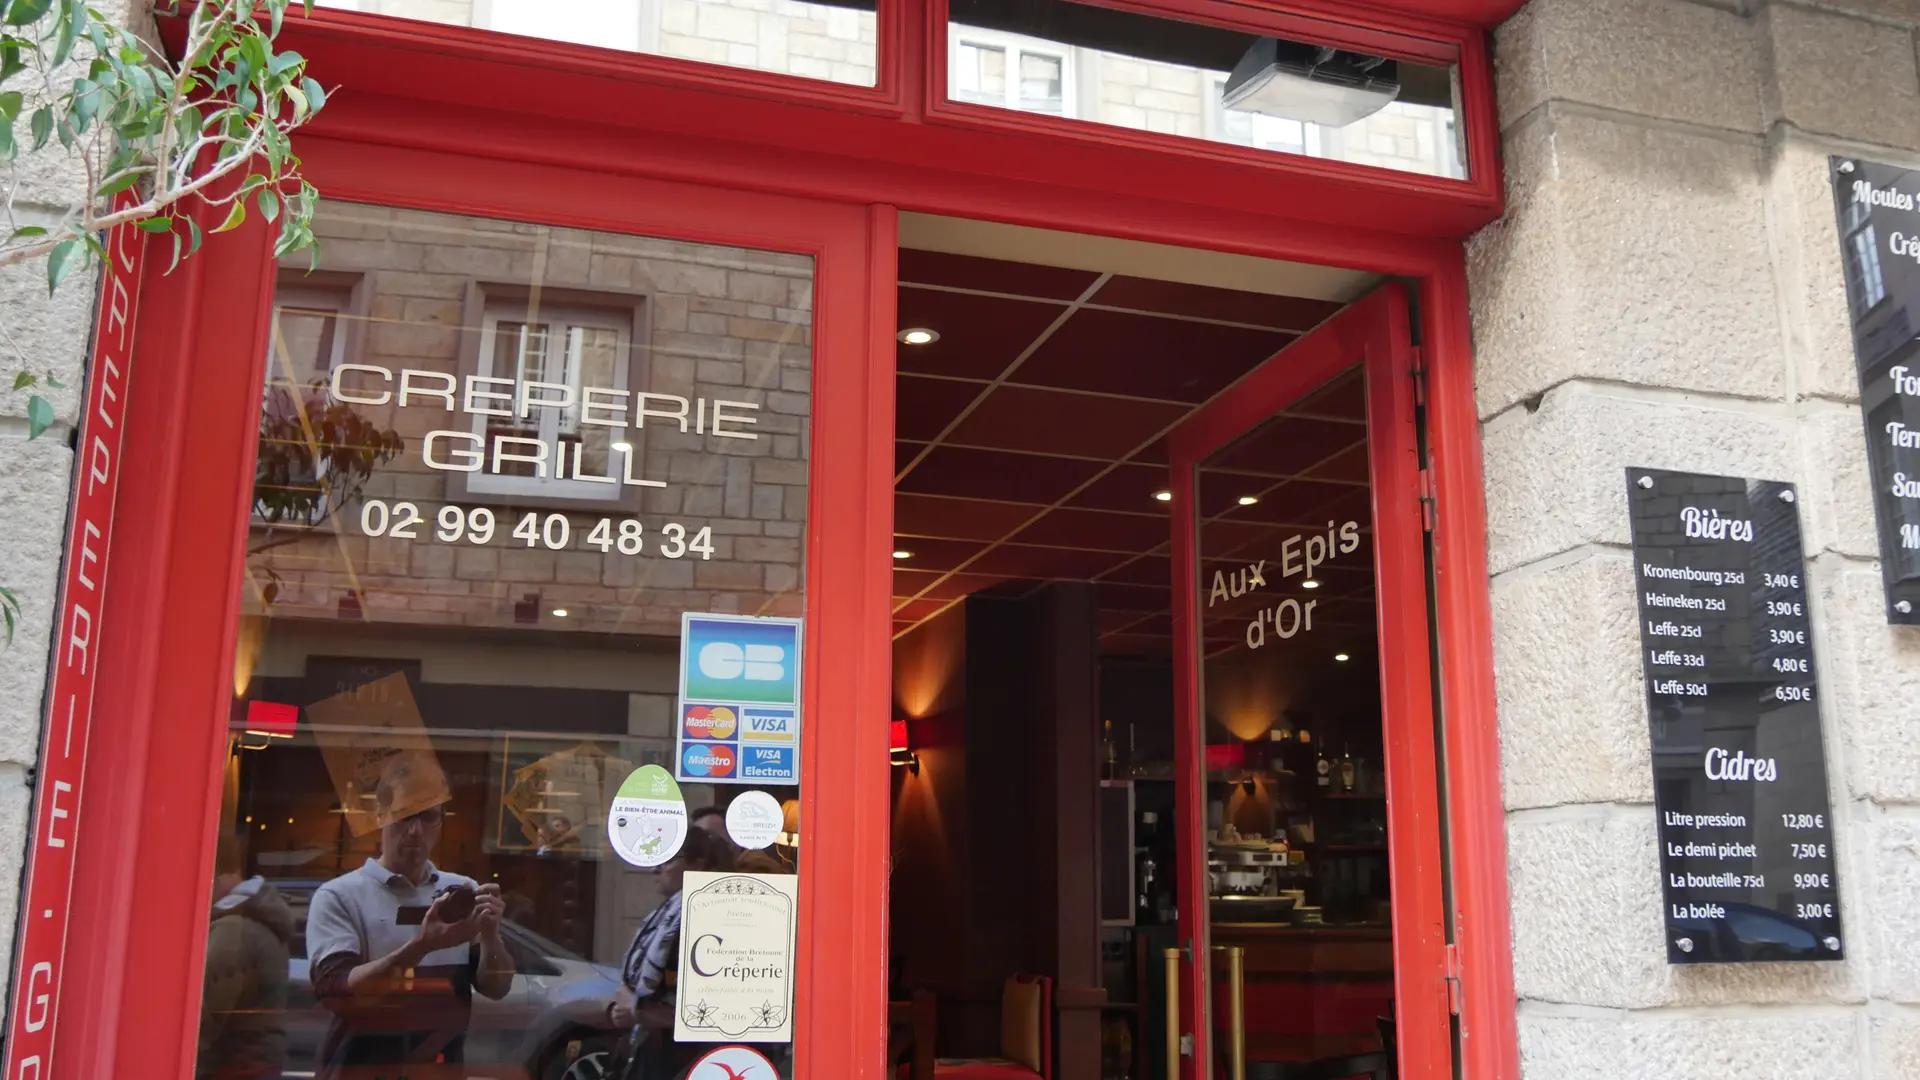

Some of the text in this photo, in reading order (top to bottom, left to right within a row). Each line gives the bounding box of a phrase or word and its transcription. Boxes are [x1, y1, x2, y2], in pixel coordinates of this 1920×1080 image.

[1852, 180, 1913, 211] Moules
[1889, 231, 1920, 264] Crê
[331, 363, 759, 440] CREPERIE
[423, 430, 667, 488] GRILL
[361, 500, 715, 560] 02 99 40 48 34
[1680, 506, 1753, 542] Bières
[1209, 519, 1360, 608] Aux Epis
[1643, 563, 1722, 586] Kronenbourg
[1724, 572, 1745, 584] 25cl
[1646, 592, 1702, 609] Heineken
[1705, 599, 1726, 611] 25cl
[1246, 598, 1317, 650] d'Or
[1649, 621, 1678, 636] Leffe
[1680, 626, 1702, 638] 25cl
[698, 642, 784, 681] CB
[1652, 650, 1681, 665] Leffe
[1683, 655, 1705, 667] 33cl
[1654, 680, 1684, 695] Leffe
[1686, 684, 1708, 696] 50cl
[686, 716, 736, 729] MasterCard
[751, 718, 787, 732] VISA
[688, 755, 730, 766] Maestro
[755, 749, 781, 759] VISA
[745, 766, 790, 777] Electron
[1704, 747, 1776, 781] Cidres
[624, 805, 658, 814] BIEN-ÊTRE
[1665, 811, 1693, 827] Litre
[1696, 812, 1746, 829] pression
[1668, 842, 1683, 857] Le
[1685, 842, 1716, 857] demi
[1718, 843, 1757, 860] pichet
[1670, 873, 1685, 888] La
[1687, 872, 1741, 888] bouteille
[1743, 875, 1764, 888] 75cl
[1673, 904, 1688, 919] La
[1690, 903, 1725, 919] bolée
[690, 934, 783, 982] Crêperie
[722, 1012, 747, 1021] 2006
